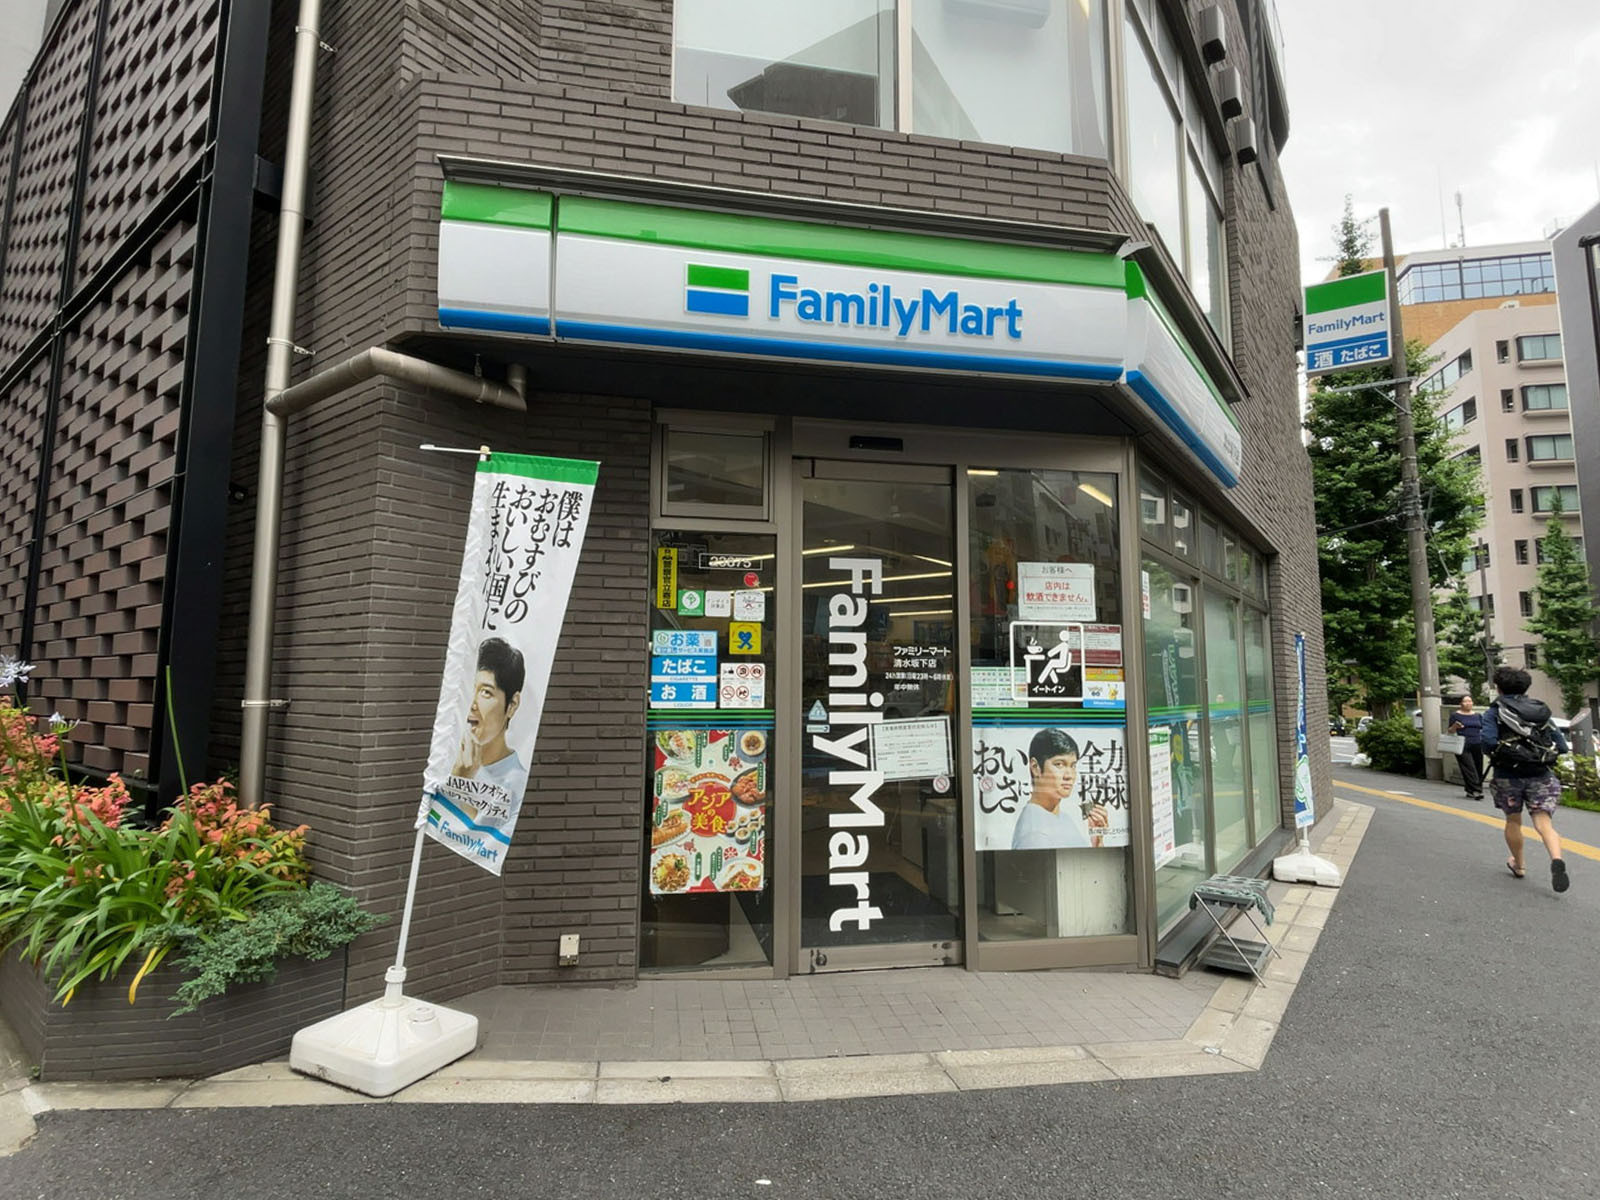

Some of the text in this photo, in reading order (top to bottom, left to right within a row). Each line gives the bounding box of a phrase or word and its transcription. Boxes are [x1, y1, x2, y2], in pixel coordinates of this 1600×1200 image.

[769, 272, 1023, 340] FamilyMart
[1308, 311, 1385, 335] FamilyMart
[1314, 343, 1382, 368] 酒 たばこ
[552, 489, 584, 549] 僕は
[504, 487, 559, 624] おむすびの
[1045, 580, 1070, 590] 店内は
[893, 646, 952, 657] ファミリーマート
[662, 658, 707, 674] たばこ
[1032, 682, 1066, 694] イートイン
[812, 557, 886, 933] FamilyMart
[688, 788, 732, 811] アジア
[692, 812, 727, 833] 美食
[440, 820, 499, 862] FamilyMart
